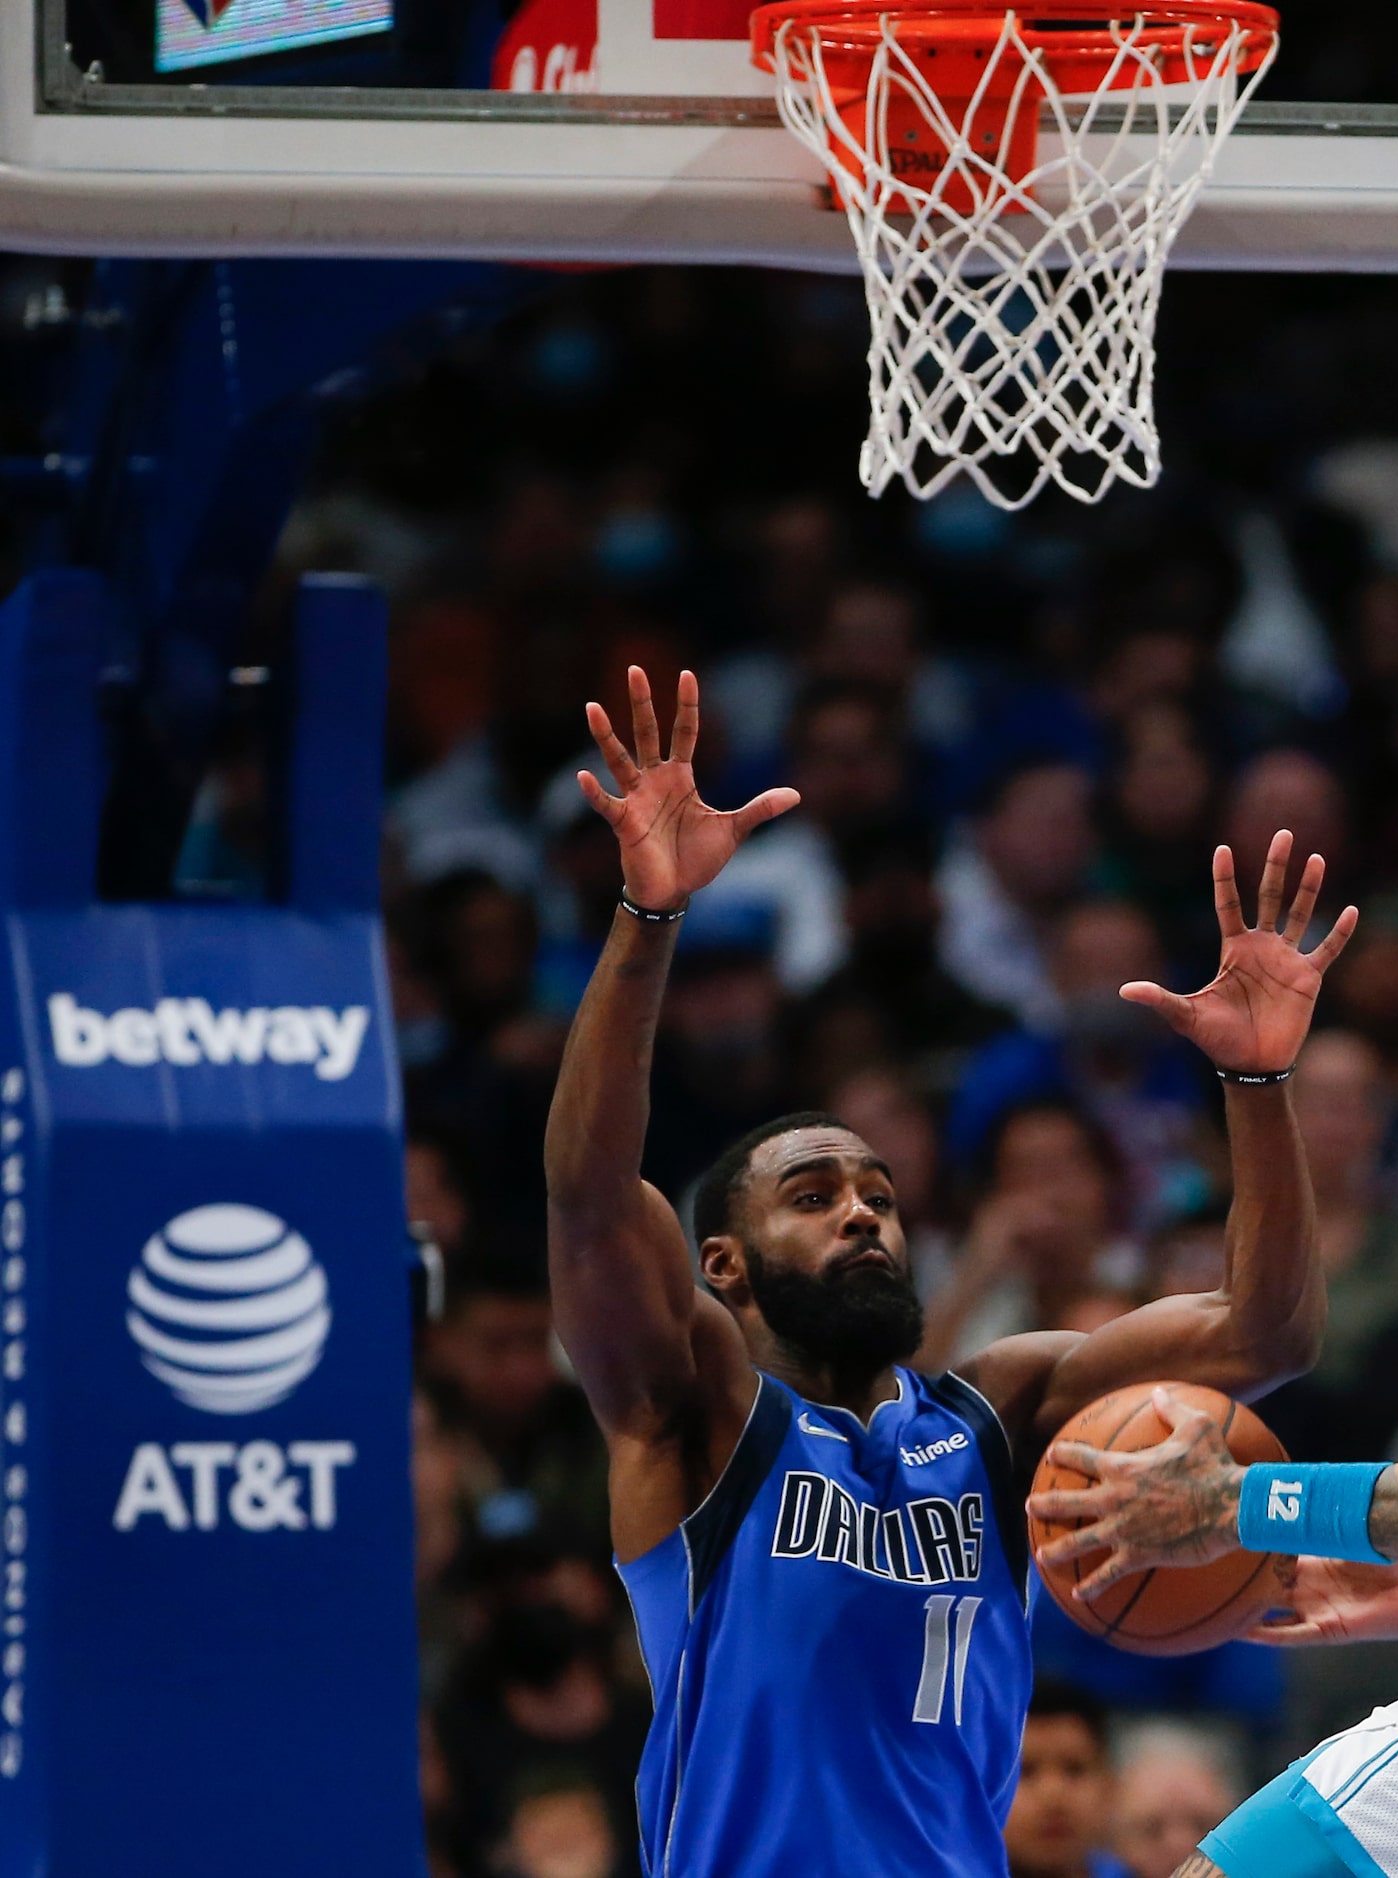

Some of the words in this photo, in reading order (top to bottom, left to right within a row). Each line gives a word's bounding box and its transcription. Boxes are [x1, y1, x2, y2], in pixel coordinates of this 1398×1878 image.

[47, 992, 370, 1082] betway
[112, 1439, 357, 1532] AT&T
[900, 1431, 969, 1467] hime
[771, 1470, 984, 1586] DALLAS
[1267, 1478, 1302, 1522] 12
[912, 1594, 983, 1727] 11
